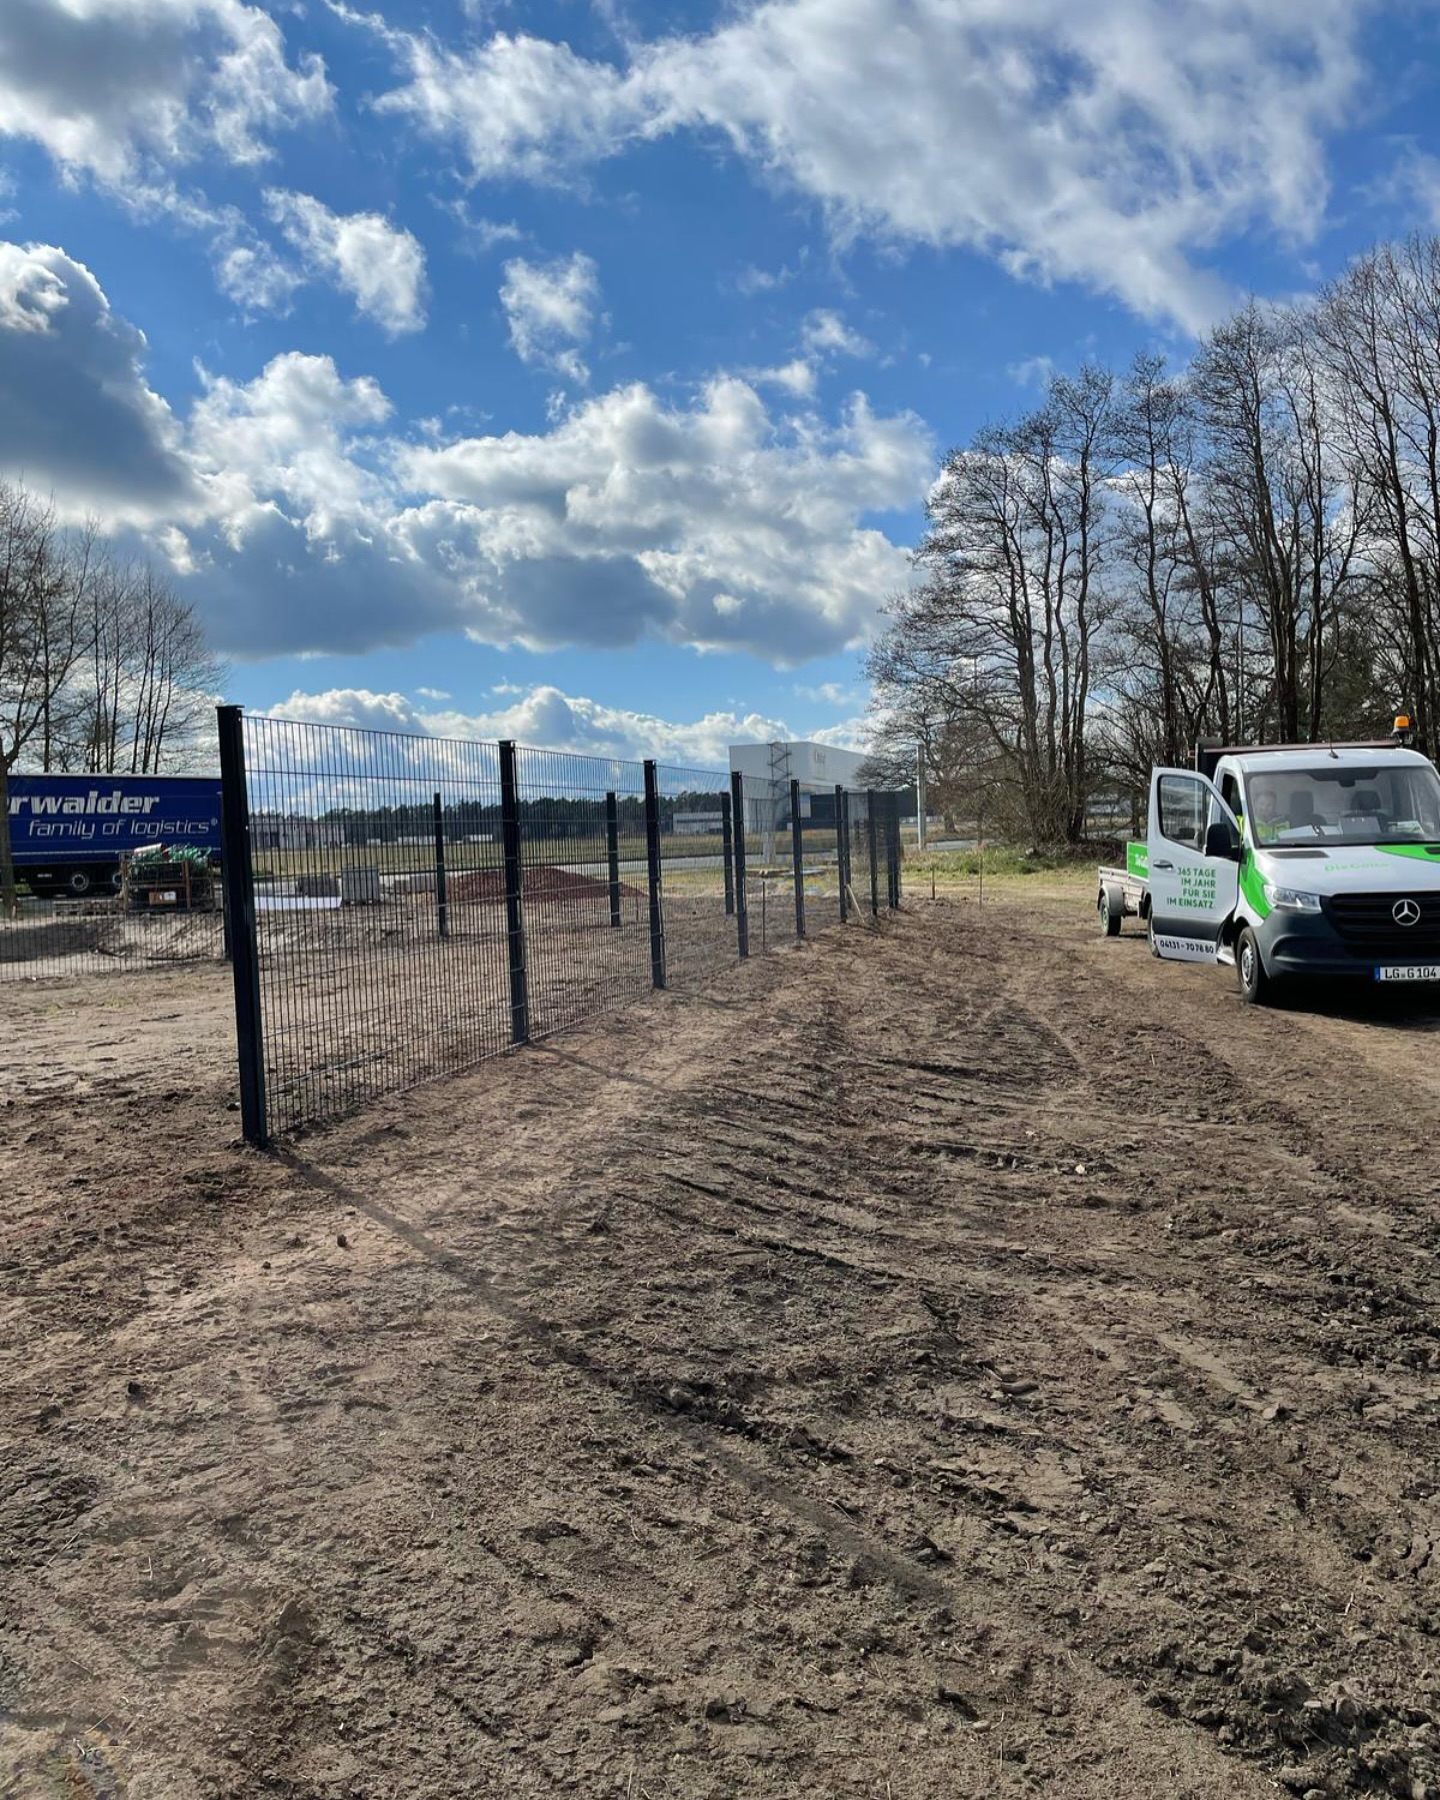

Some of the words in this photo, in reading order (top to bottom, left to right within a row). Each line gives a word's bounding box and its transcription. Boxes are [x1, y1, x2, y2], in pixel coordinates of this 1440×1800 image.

[7, 791, 160, 814] rwalder
[29, 820, 95, 840] family
[102, 819, 126, 835] of
[1177, 867, 1191, 876] 365
[1193, 868, 1216, 877] TAGE
[1181, 878, 1191, 887] IM
[1193, 879, 1216, 888] JAHR
[1202, 890, 1216, 899] SIE
[1167, 897, 1177, 906] IM
[1385, 967, 1400, 979] LG
